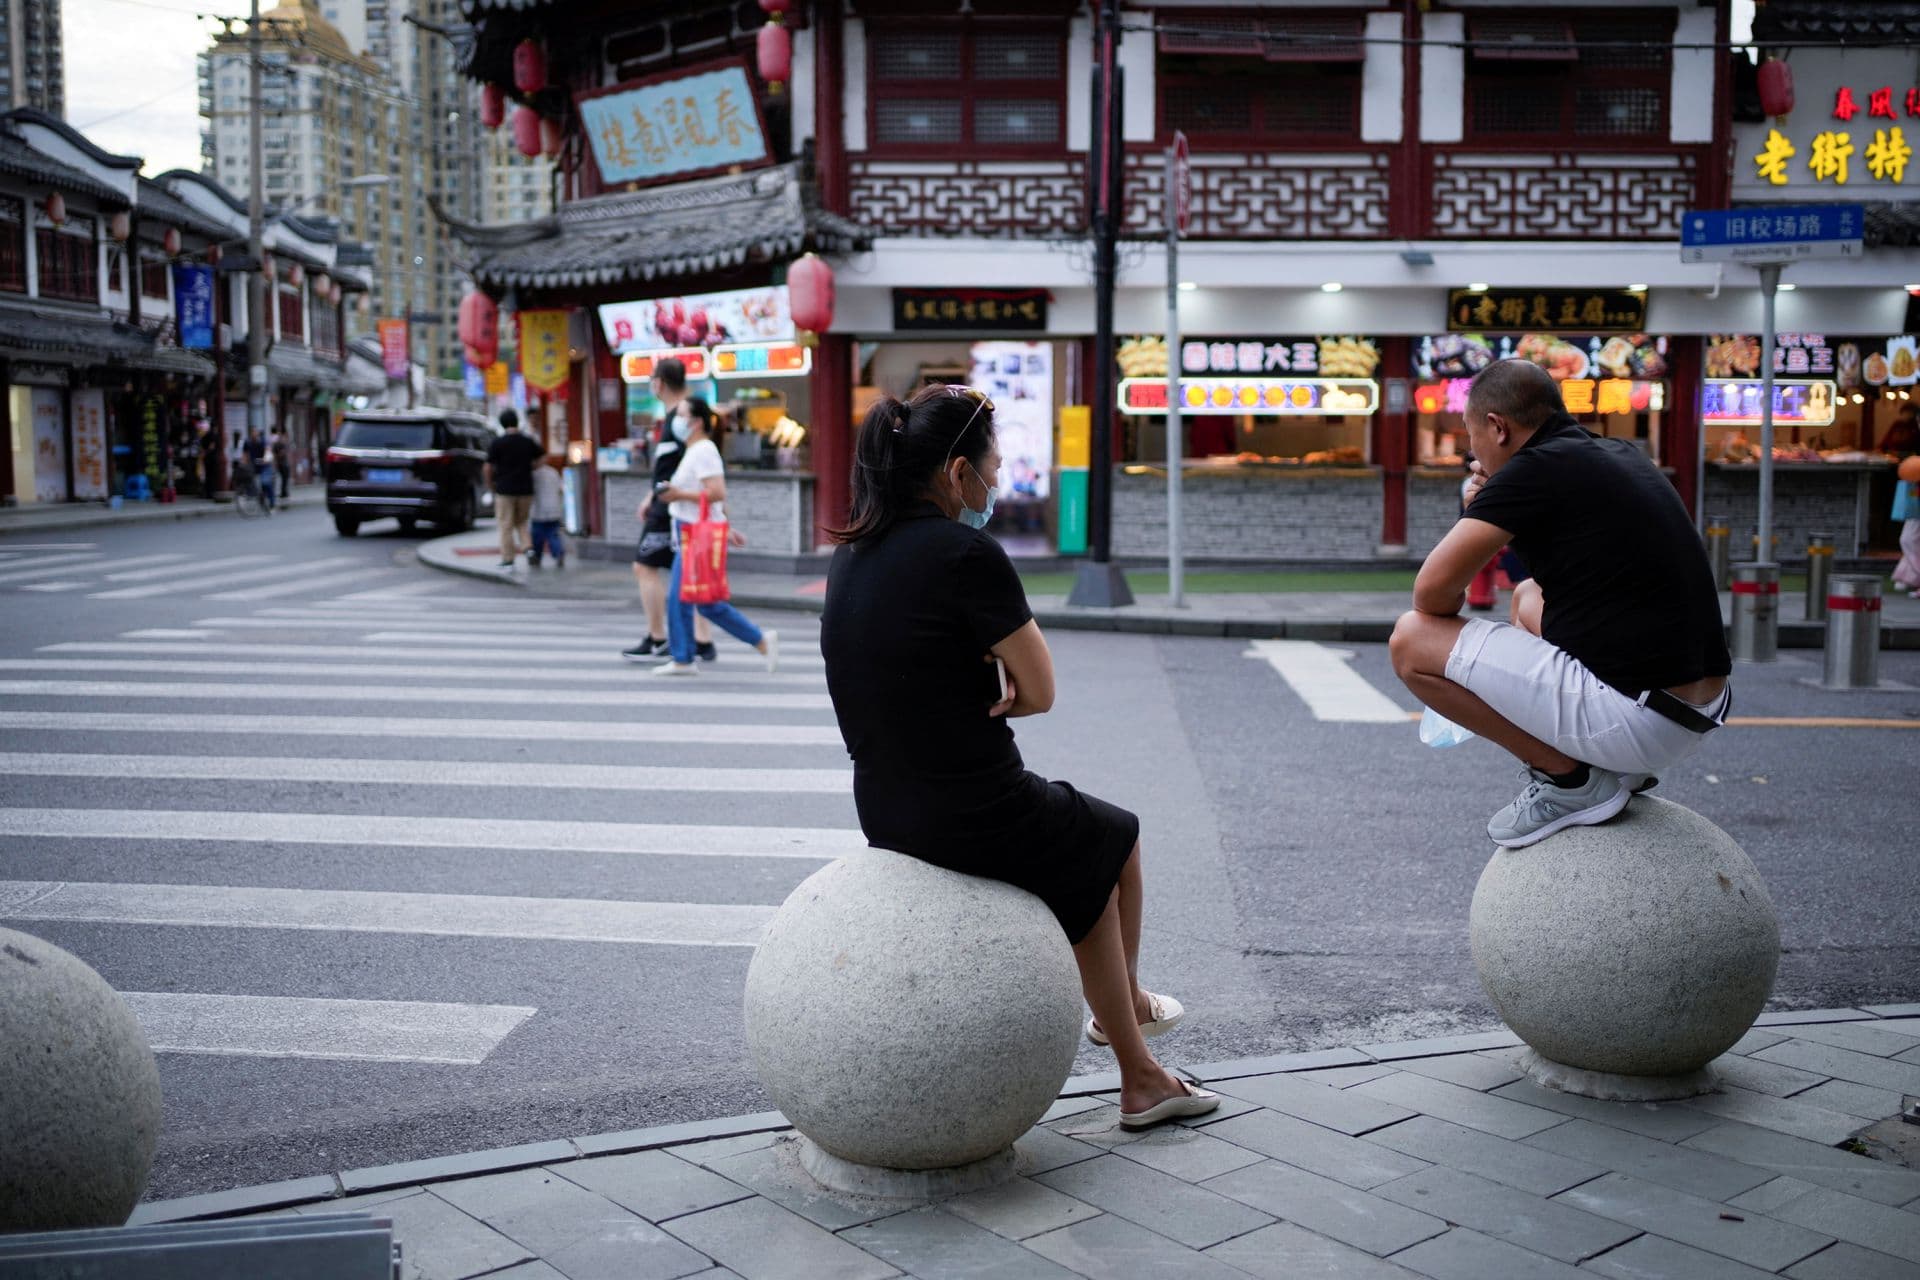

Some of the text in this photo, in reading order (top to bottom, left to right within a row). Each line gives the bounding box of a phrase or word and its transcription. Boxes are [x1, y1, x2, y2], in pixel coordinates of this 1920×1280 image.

[1754, 127, 1913, 185] 老街特
[1725, 214, 1822, 239] 旧校场路
